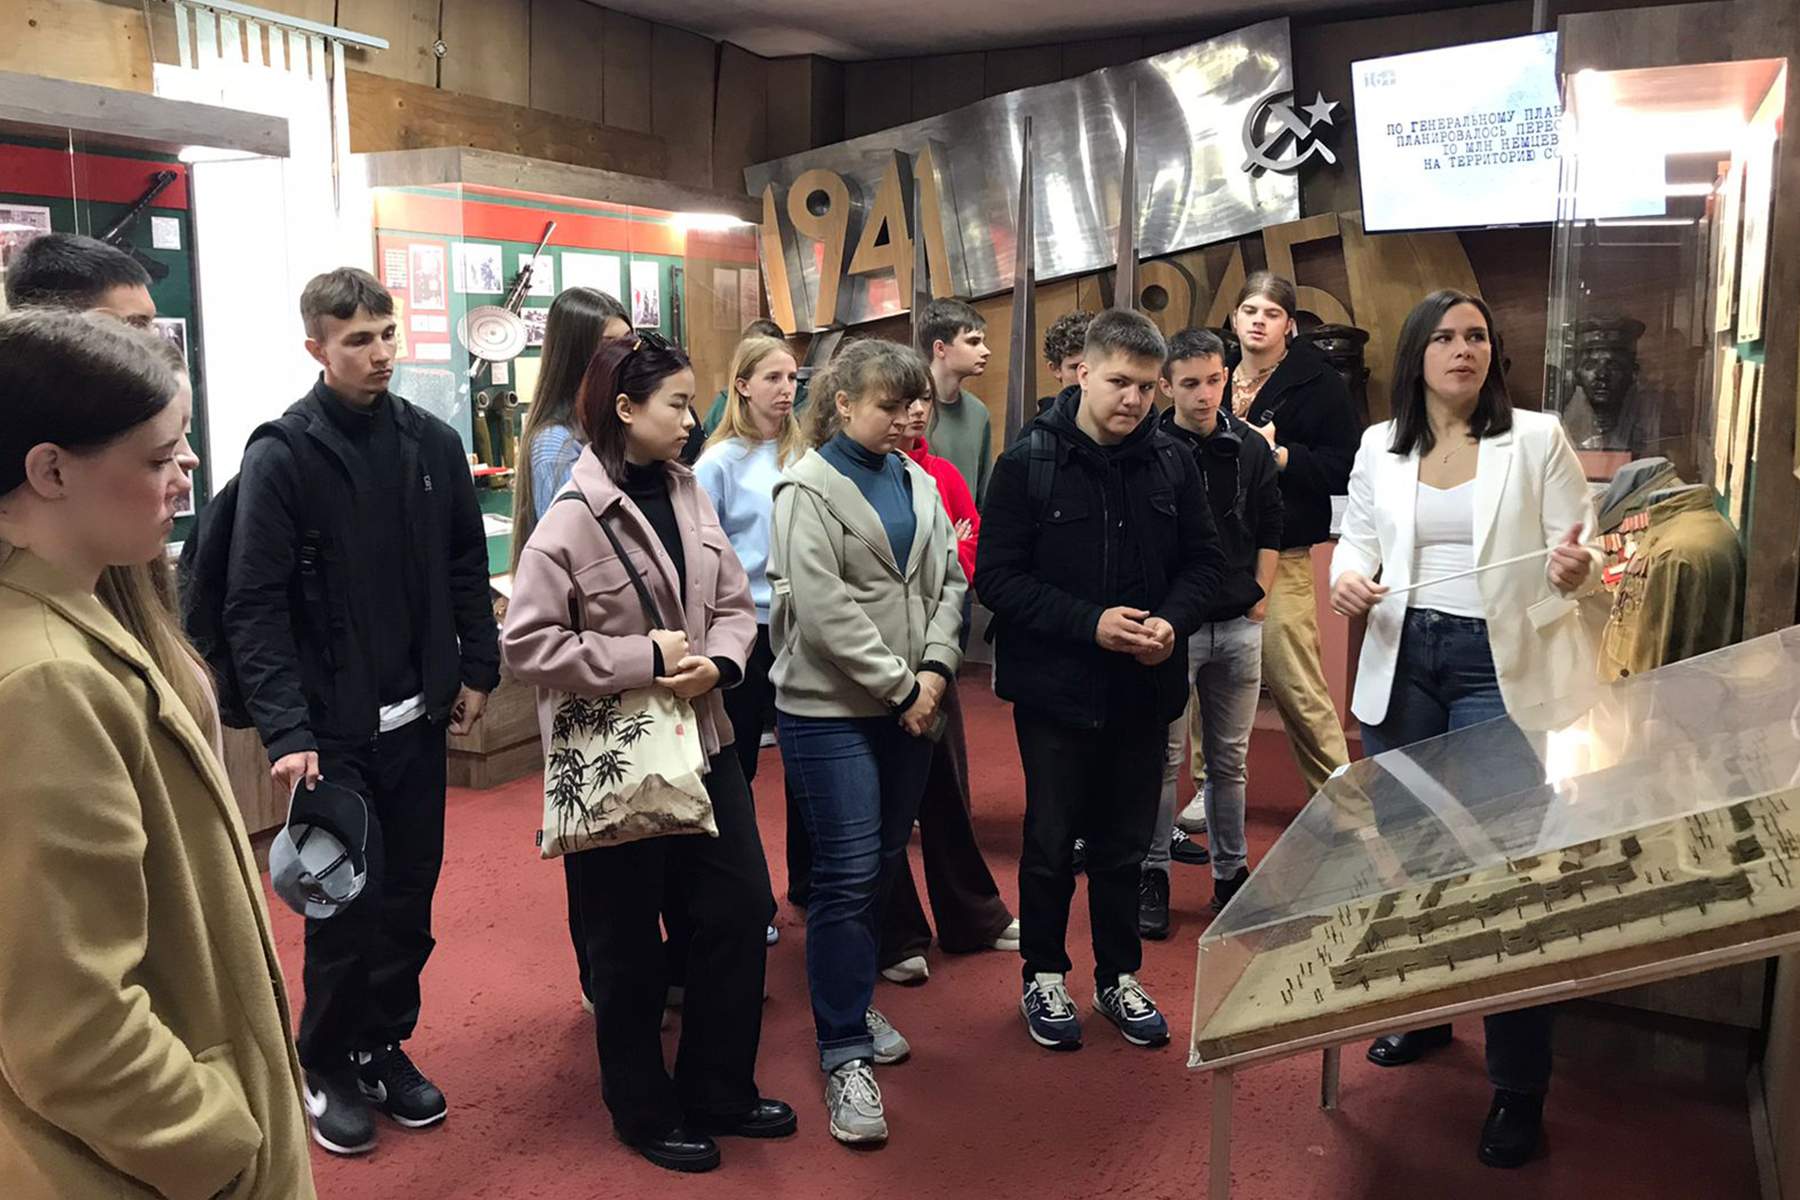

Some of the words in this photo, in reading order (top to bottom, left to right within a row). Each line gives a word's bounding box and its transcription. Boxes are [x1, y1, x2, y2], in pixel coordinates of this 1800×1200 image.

[1387, 122, 1403, 136] ПО
[1411, 110, 1516, 133] ГЕНЕРАЛЬНОМУ
[1396, 125, 1507, 147] ПЛАНИРОВАЛОСЬ
[1465, 140, 1493, 153] МЛН
[1501, 133, 1559, 150] НЕМЦЕВ
[1424, 158, 1441, 170] НА
[1448, 149, 1536, 168] ТЕРРИТОРИЮ
[759, 143, 955, 335] 1941
